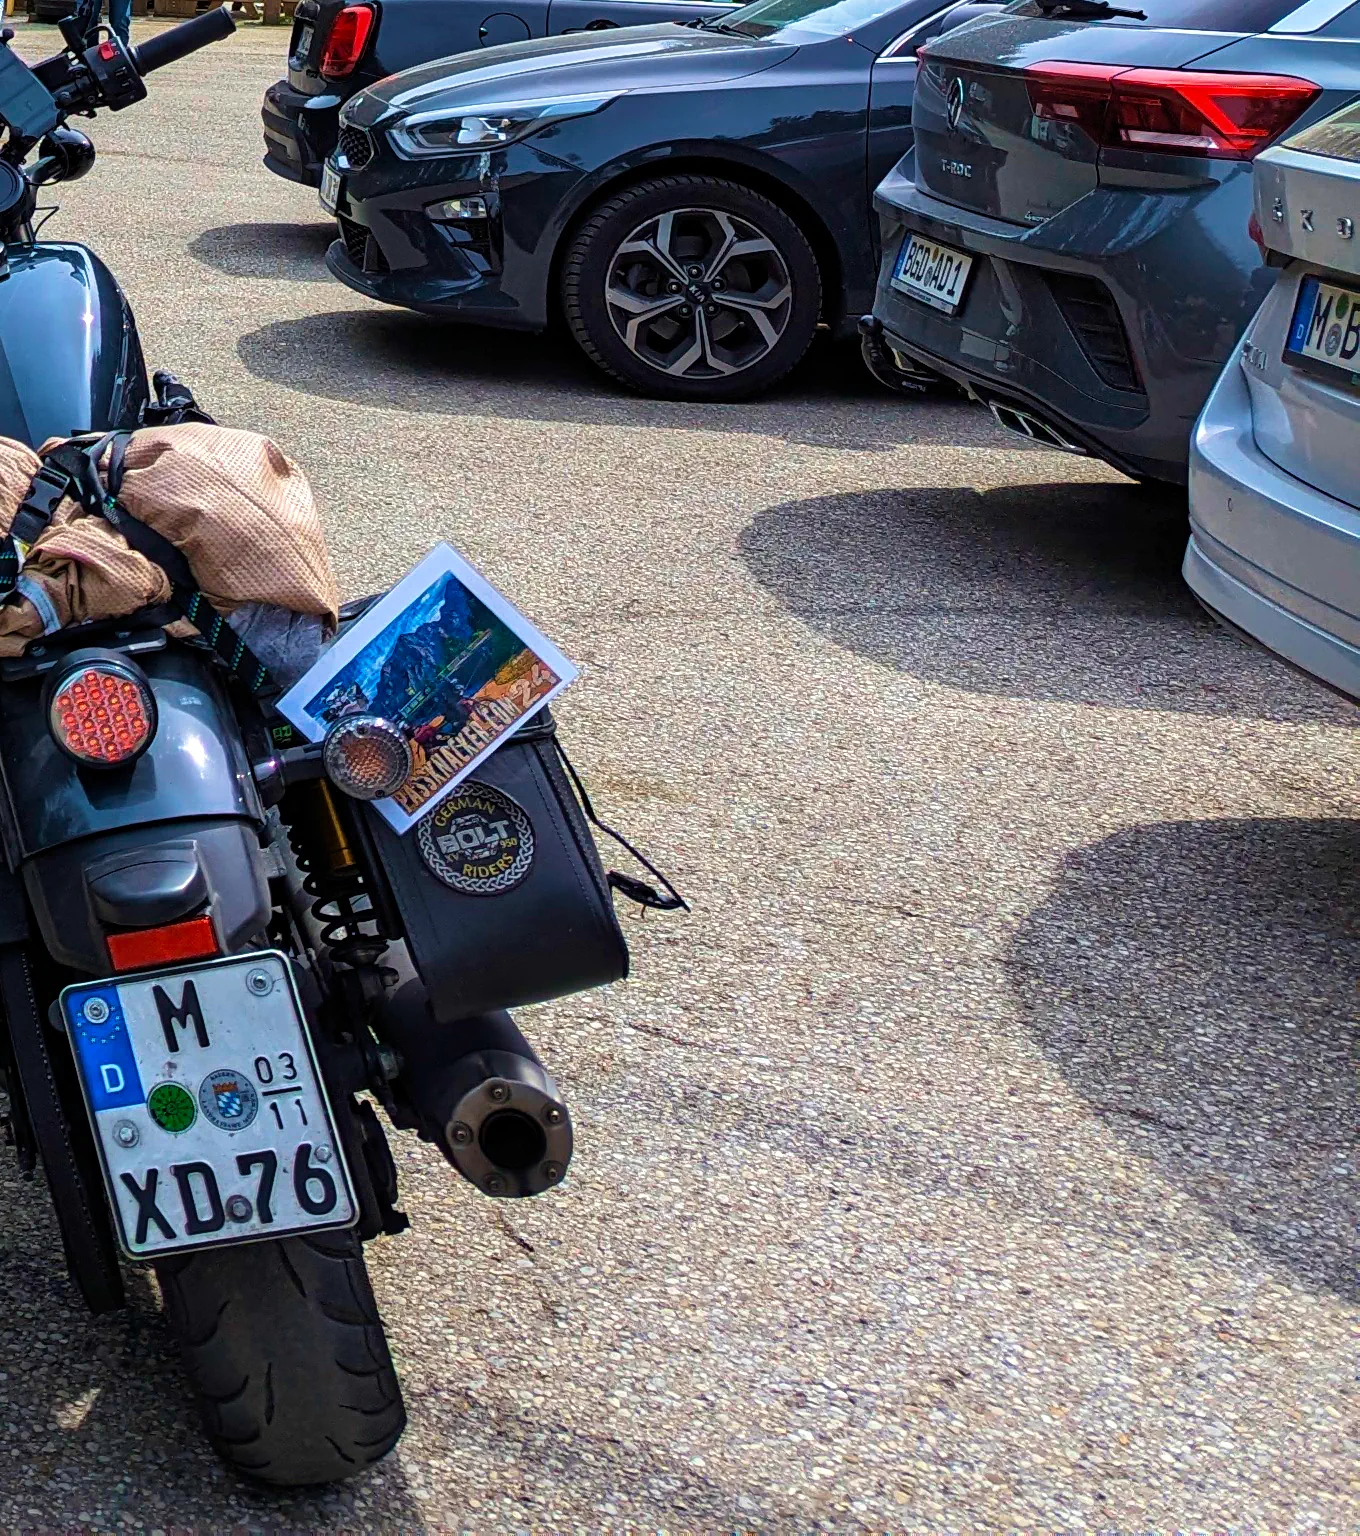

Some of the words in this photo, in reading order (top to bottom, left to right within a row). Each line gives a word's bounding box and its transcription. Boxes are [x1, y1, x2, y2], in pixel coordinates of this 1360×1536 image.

[941, 159, 972, 177] T-ROC
[903, 241, 930, 282] BGD
[929, 252, 953, 292] AD
[946, 260, 963, 296] 1
[688, 285, 705, 302] KIA
[1306, 292, 1334, 350] M
[434, 796, 496, 828] GERMAN
[436, 819, 510, 854] BOLT
[499, 837, 518, 849] 950
[463, 852, 514, 878] RIDERS
[151, 979, 211, 1053] M
[99, 1063, 126, 1094] D
[253, 1052, 298, 1084] 03
[269, 1098, 309, 1130] 11
[119, 1161, 226, 1244] XD
[235, 1141, 338, 1225] 76
